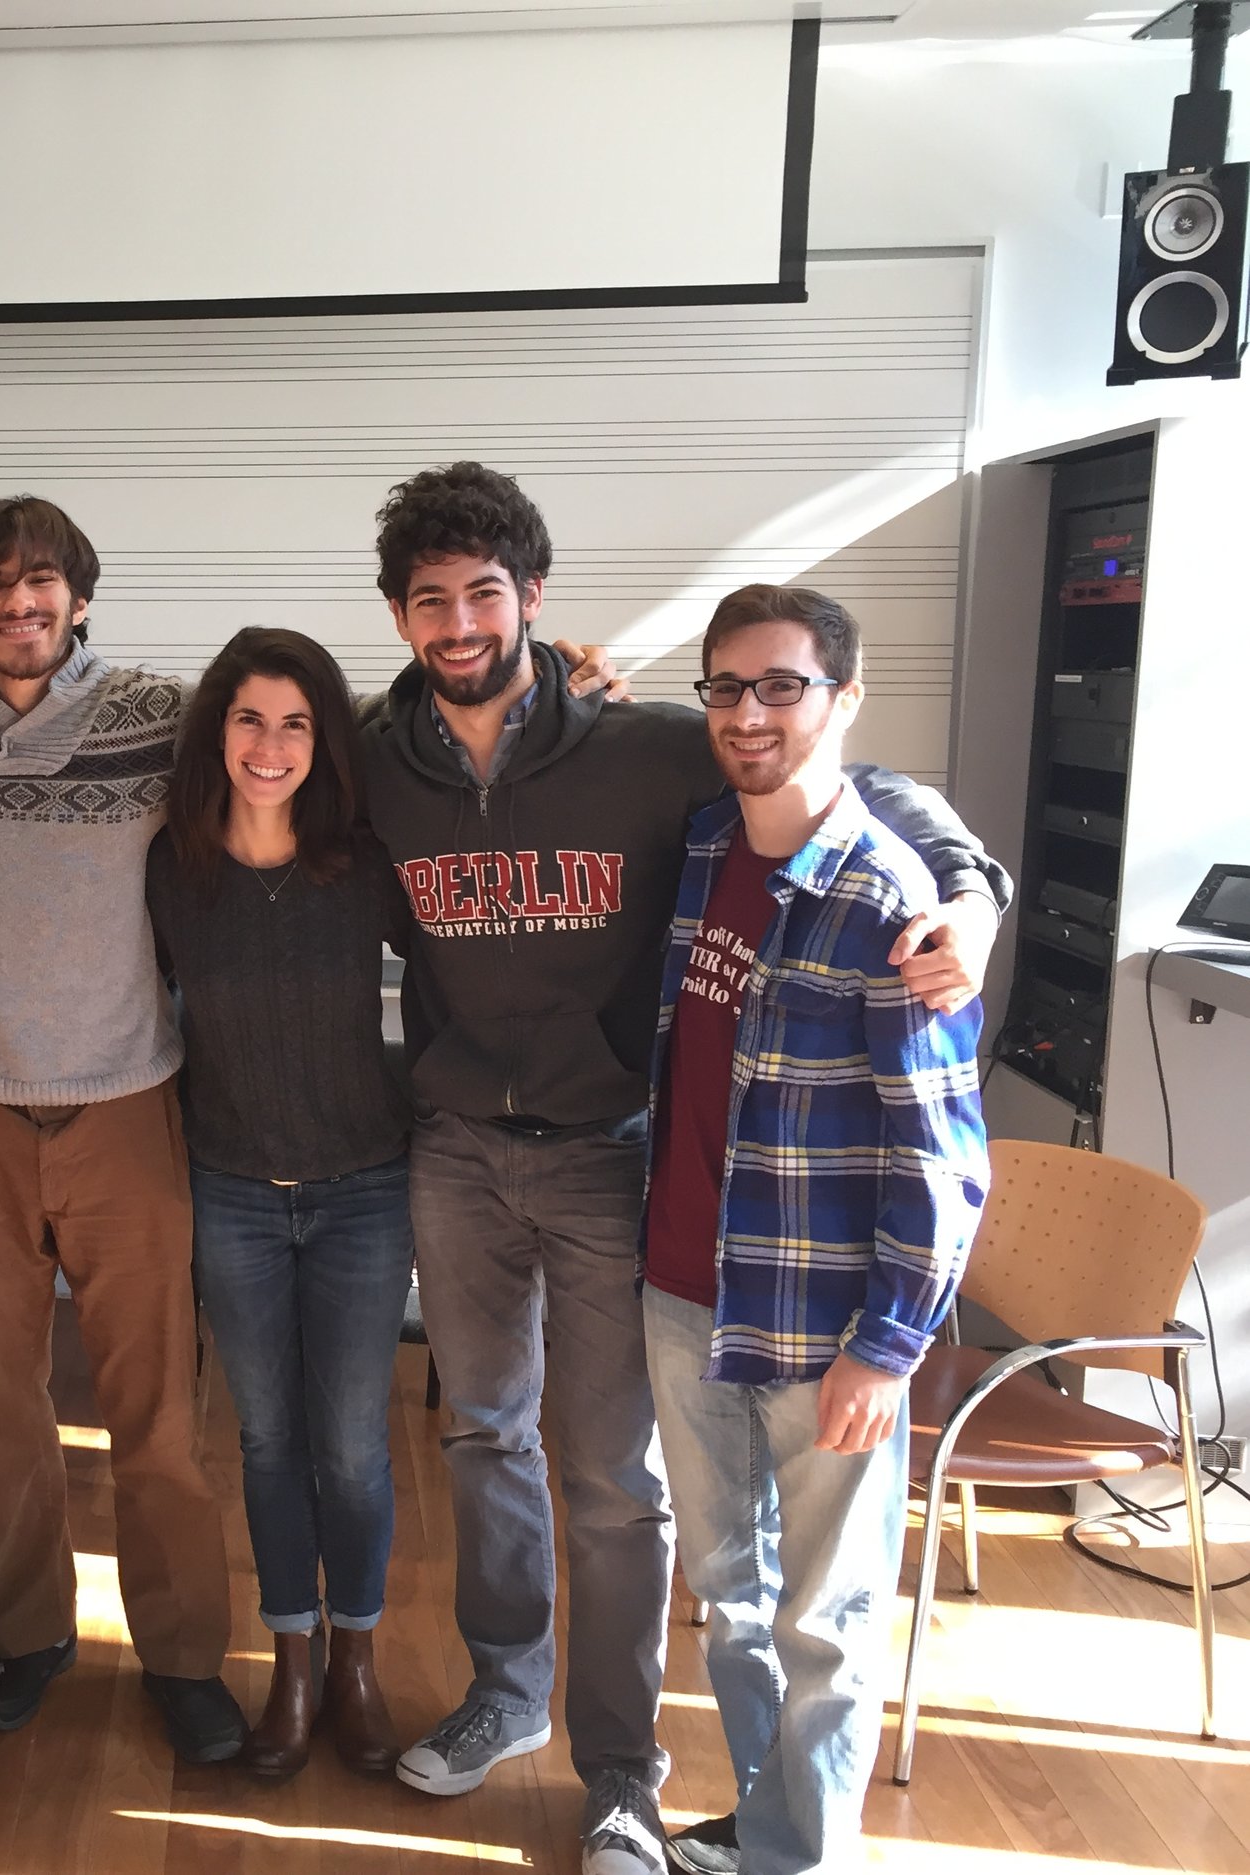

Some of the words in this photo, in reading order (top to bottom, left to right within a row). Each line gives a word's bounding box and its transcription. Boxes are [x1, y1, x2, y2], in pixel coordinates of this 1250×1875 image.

[394, 850, 623, 922] BERLIN
[525, 919, 545, 933] OF
[554, 916, 607, 932] MUSIC
[689, 945, 722, 973] TER
[731, 937, 755, 964] hav
[680, 976, 707, 997] raid
[708, 981, 730, 1004] to
